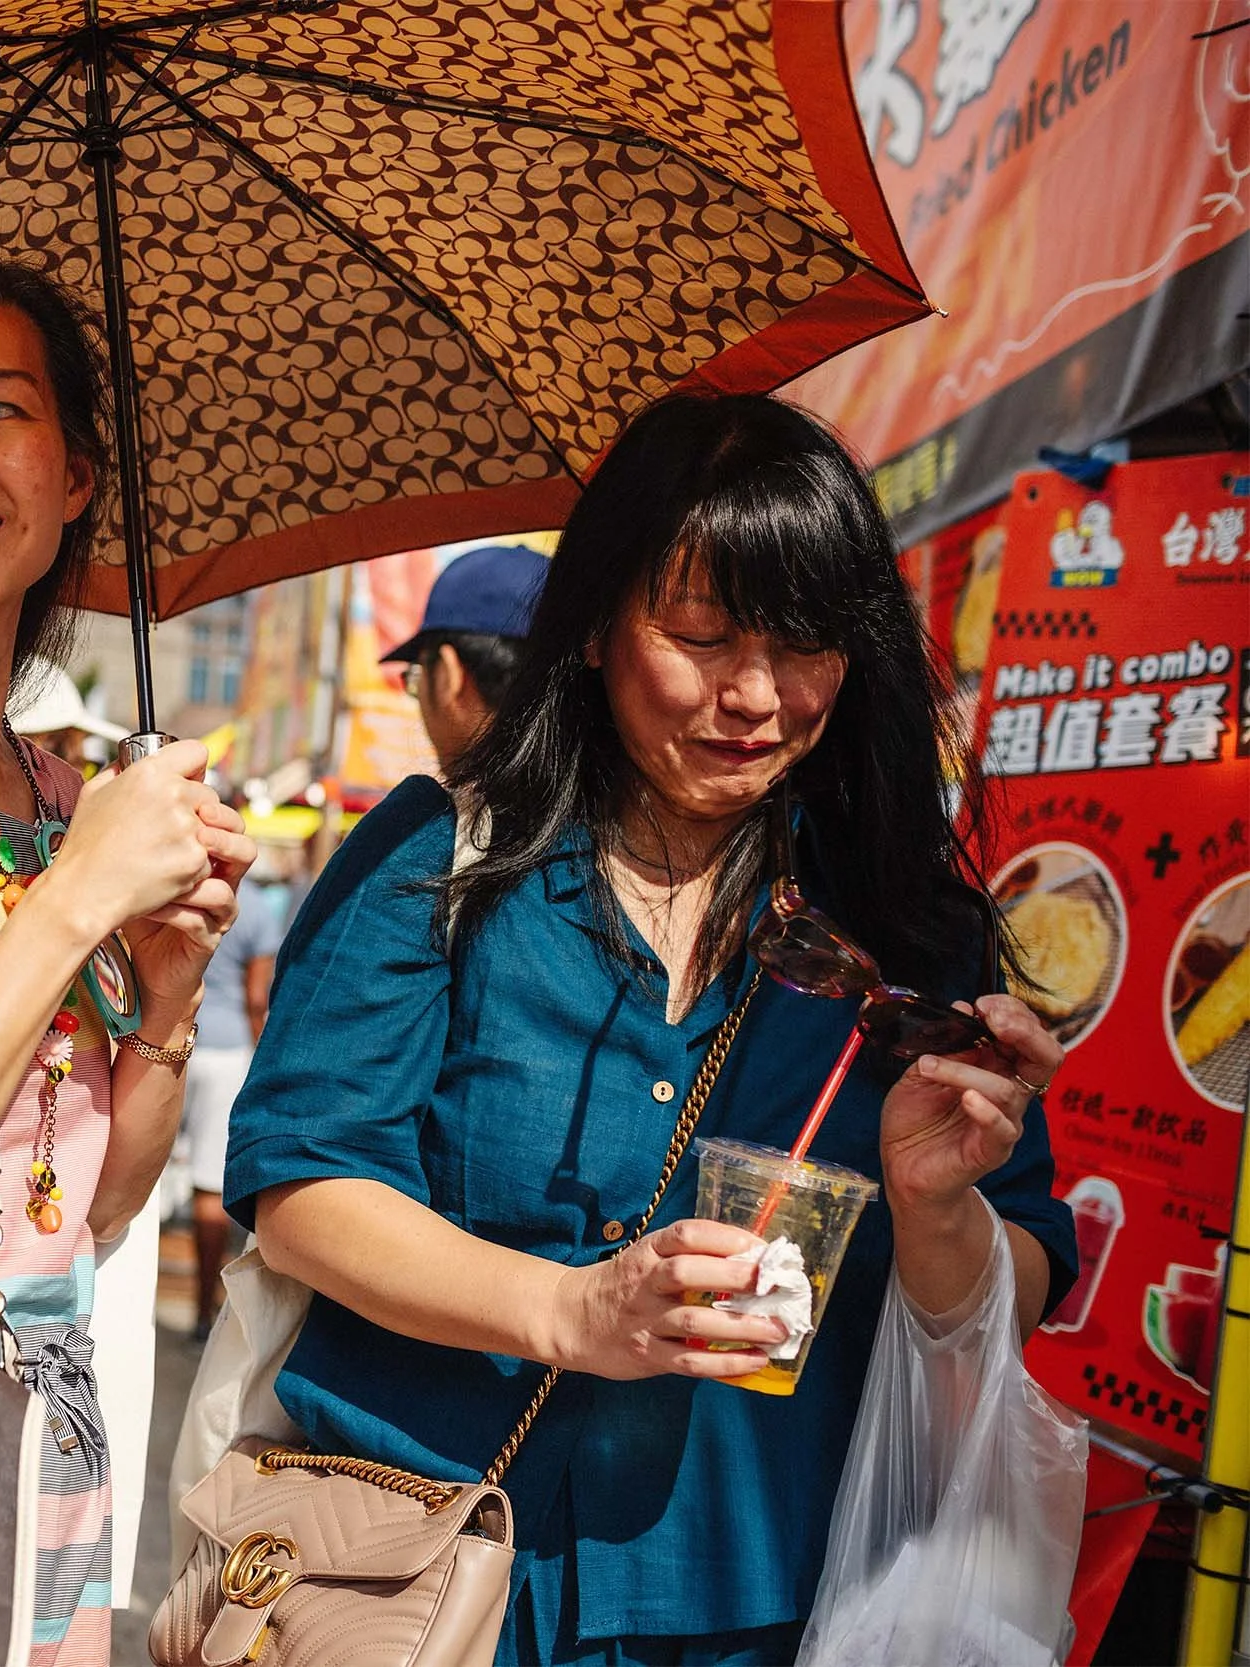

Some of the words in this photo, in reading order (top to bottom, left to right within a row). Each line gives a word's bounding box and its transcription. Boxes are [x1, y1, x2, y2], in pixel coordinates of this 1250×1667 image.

[1161, 507, 1250, 568] 台灣
[995, 661, 1076, 700] Make
[1083, 655, 1113, 690] it
[1120, 640, 1230, 685] combo
[983, 683, 1228, 776] 超值套餐
